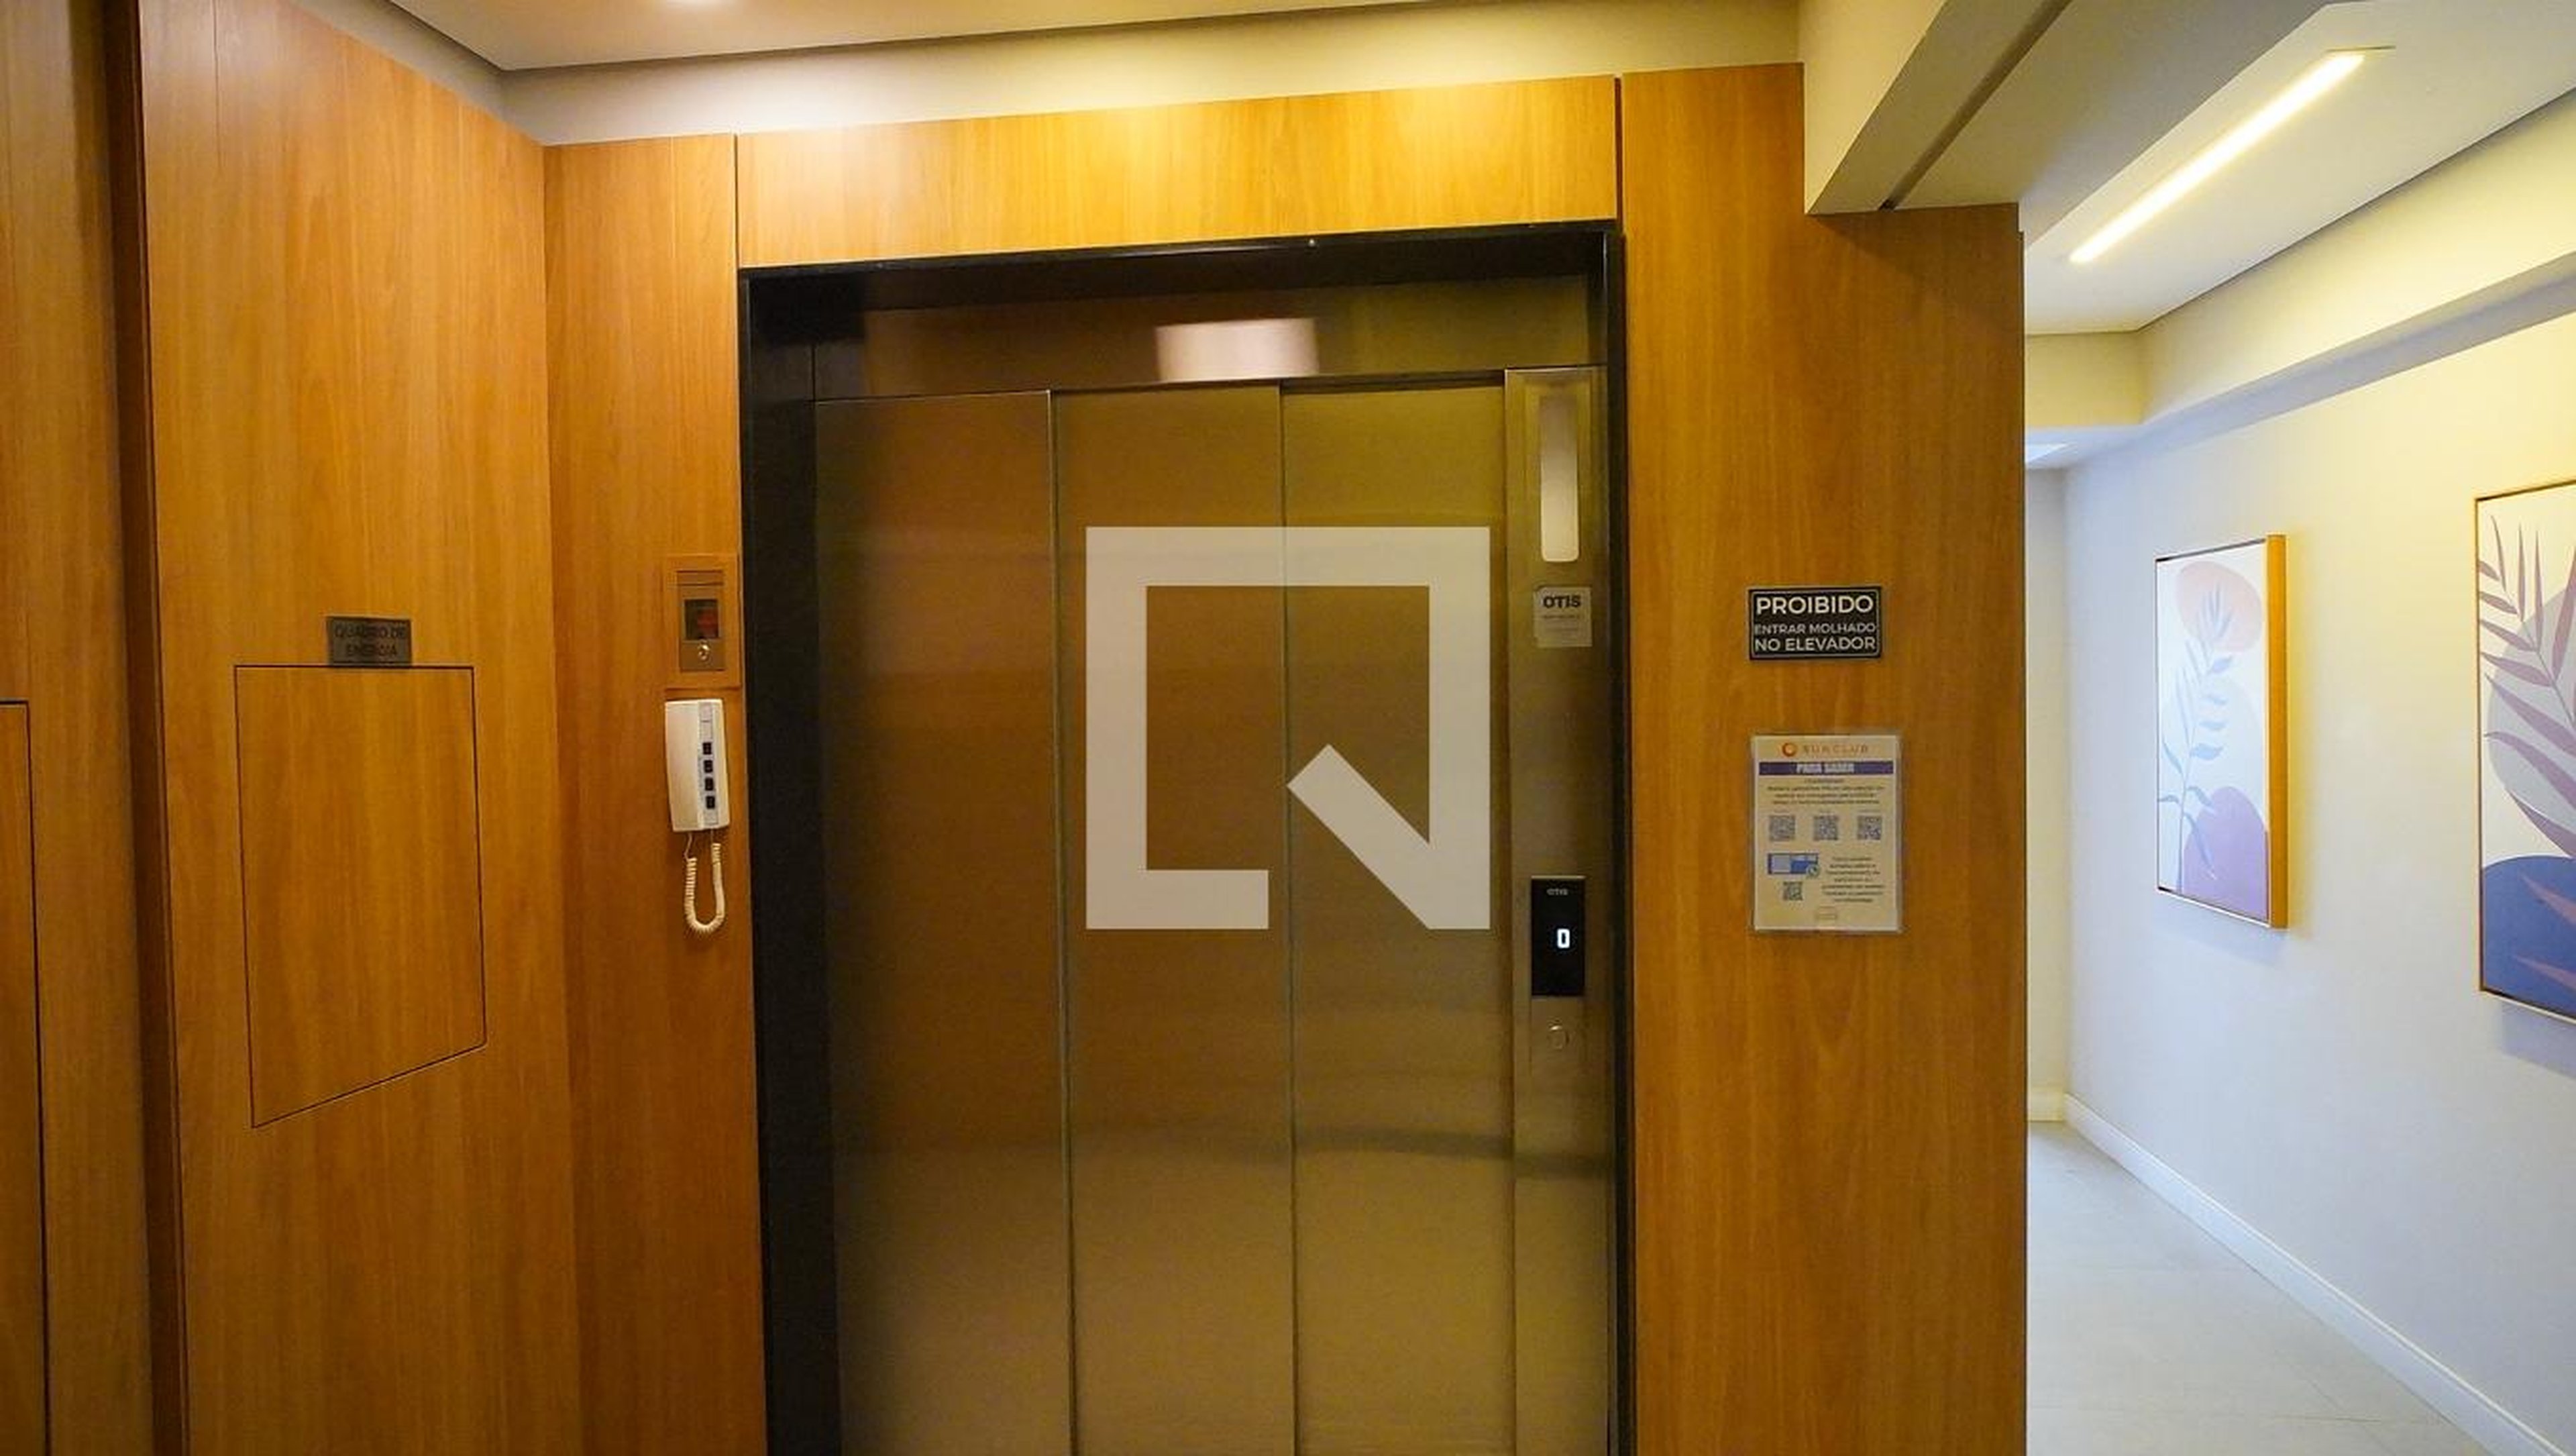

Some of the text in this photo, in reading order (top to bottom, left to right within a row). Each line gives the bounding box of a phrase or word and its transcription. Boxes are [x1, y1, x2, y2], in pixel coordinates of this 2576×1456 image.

[1543, 595, 1581, 608] OTIS
[1756, 595, 1874, 615] PROIBIDO
[1754, 623, 1876, 635] ENTRAR MOLHADO
[1755, 637, 1876, 652] NO ELEVADOR
[1556, 927, 1570, 949] 0
